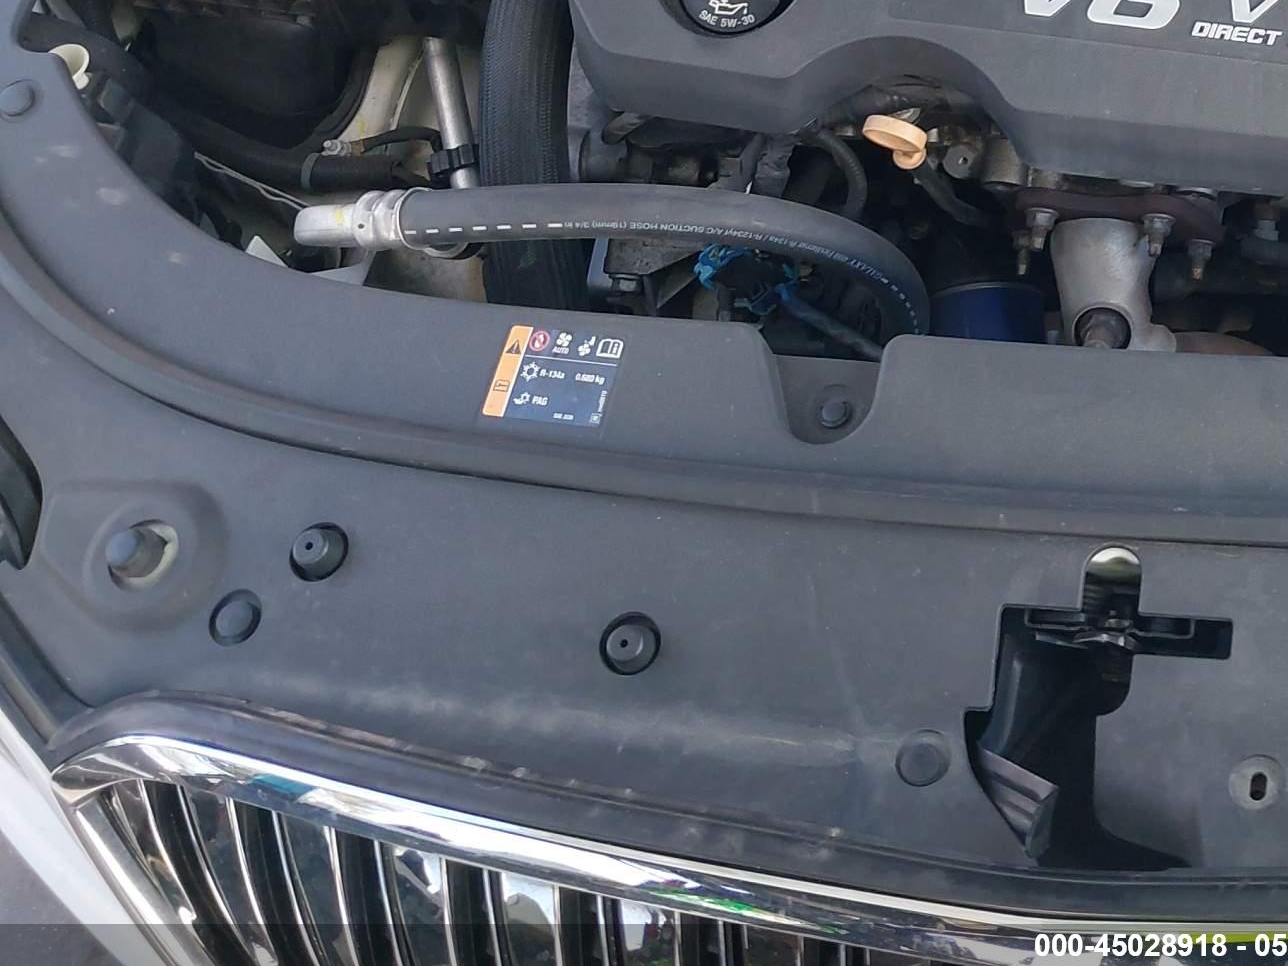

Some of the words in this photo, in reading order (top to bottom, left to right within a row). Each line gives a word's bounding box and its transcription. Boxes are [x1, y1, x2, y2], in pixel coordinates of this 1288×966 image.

[699, 10, 718, 25] SAE
[720, 14, 756, 28] 5W-30
[1191, 20, 1283, 46] DIRECT
[629, 221, 658, 230] HOSE
[660, 223, 705, 234] SUCTION
[725, 228, 762, 241] R-1234yf
[552, 346, 570, 355] AUTO
[540, 368, 565, 379] R-134a
[595, 374, 605, 386] kg
[531, 395, 548, 406] PAG
